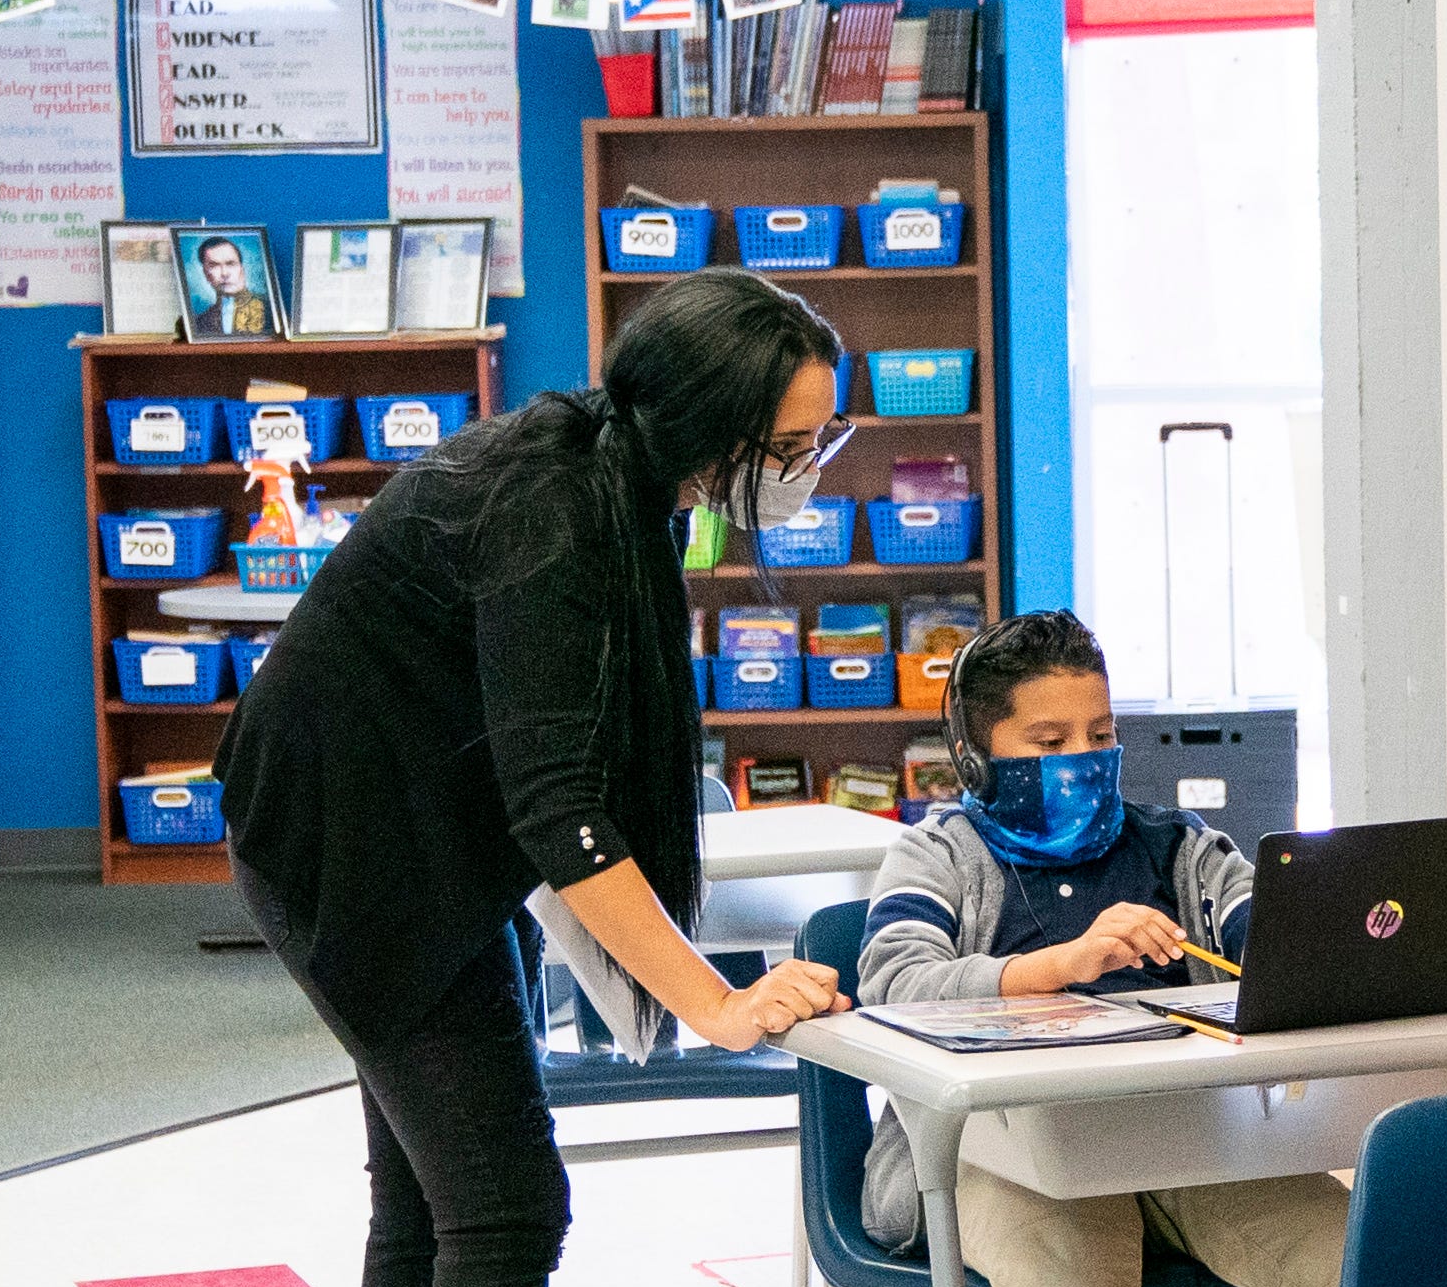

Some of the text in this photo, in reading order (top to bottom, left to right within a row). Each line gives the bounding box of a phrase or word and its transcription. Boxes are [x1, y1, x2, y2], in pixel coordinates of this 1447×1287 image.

[76, 81, 112, 101] para
[406, 92, 430, 104] am
[433, 89, 467, 104] here
[470, 88, 488, 104] to
[445, 108, 514, 128] help you.
[403, 159, 425, 172] will
[428, 160, 465, 172] listen
[467, 160, 483, 172] to
[393, 185, 421, 204] You
[425, 185, 450, 203] will
[0, 210, 84, 224] Yo creo en
[627, 227, 670, 249] 900
[892, 218, 935, 240] 1000
[256, 424, 300, 443] 500
[390, 420, 434, 439] 700
[126, 540, 169, 560] 700
[1367, 899, 1403, 939] hp
